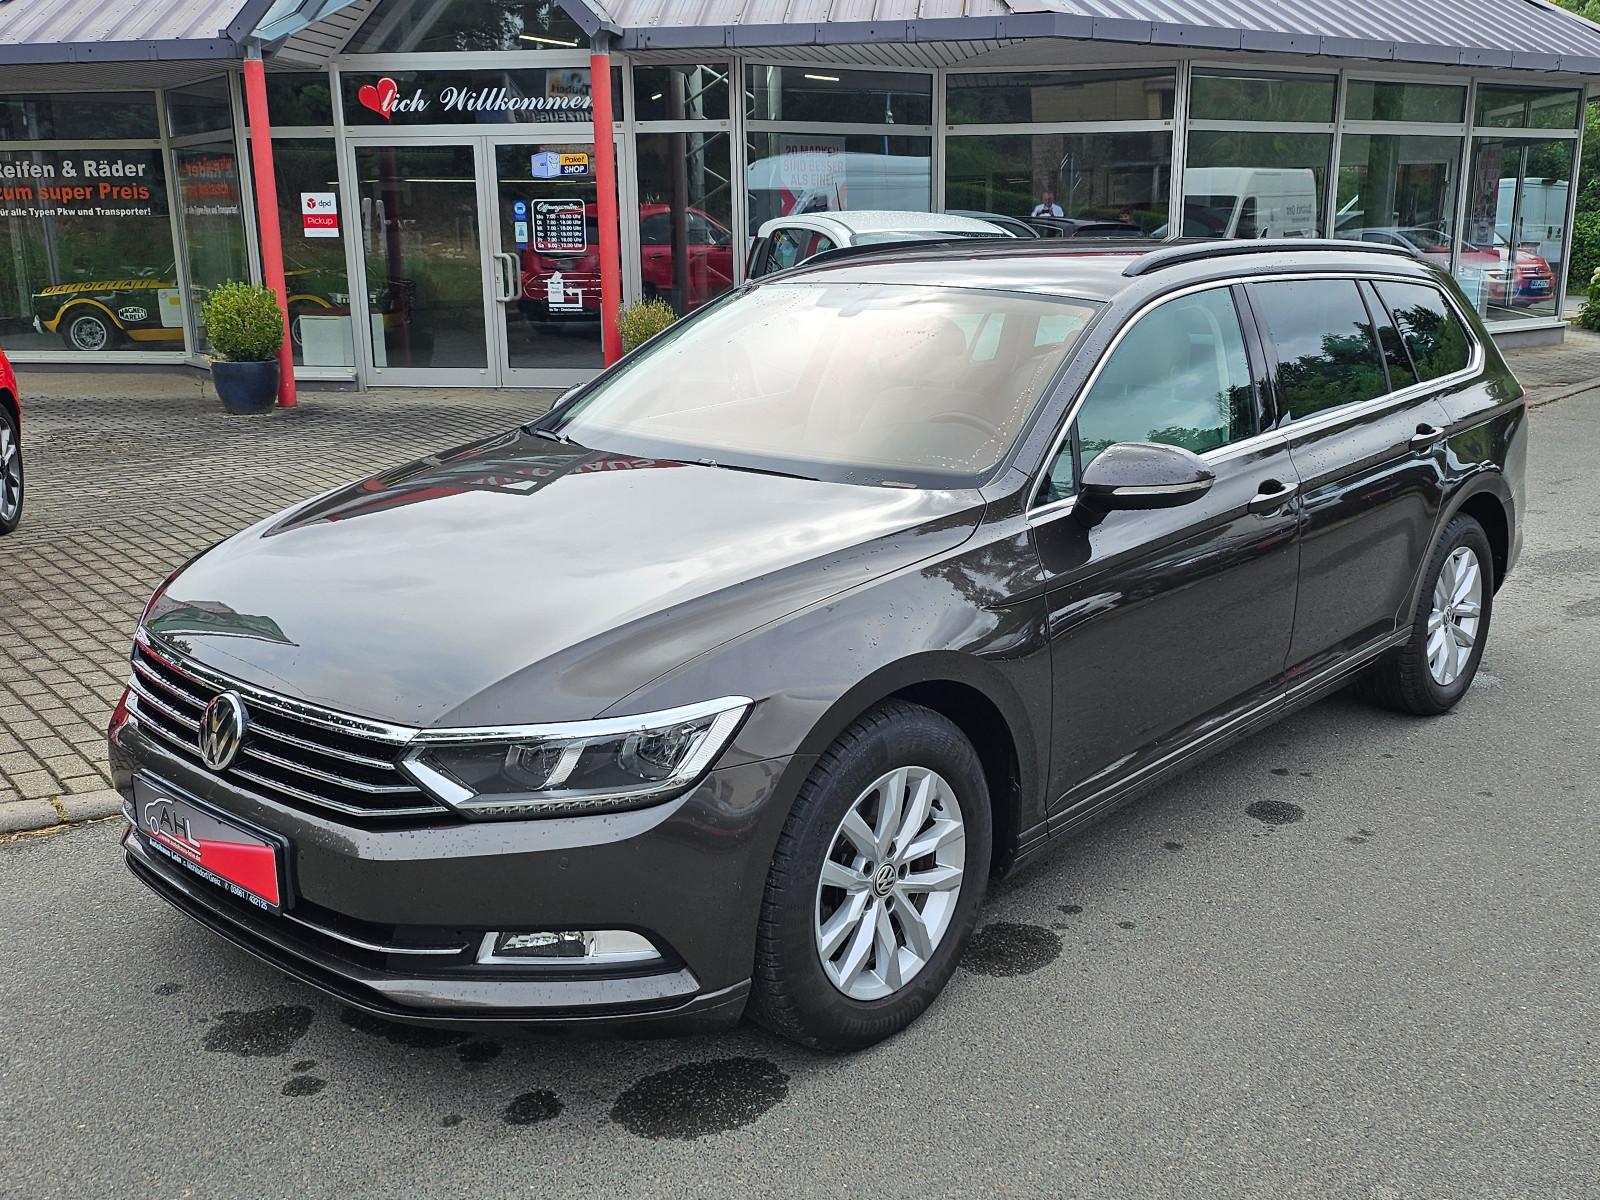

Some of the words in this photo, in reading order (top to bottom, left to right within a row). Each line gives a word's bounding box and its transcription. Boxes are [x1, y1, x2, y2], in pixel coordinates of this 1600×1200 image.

[381, 88, 431, 112] lich
[564, 156, 585, 164] Paket
[0, 161, 55, 178] eifen
[61, 160, 77, 178] &
[83, 160, 146, 177] Räder
[564, 165, 585, 174] SHOP
[38, 186, 93, 203] super
[98, 182, 150, 199] Preis
[318, 200, 331, 208] dpd
[0, 208, 8, 217] ür
[11, 208, 27, 217] alle
[29, 208, 55, 218] Typen
[57, 207, 76, 216] Pkw
[77, 207, 94, 216] und
[95, 207, 151, 217] Transporter!
[307, 216, 334, 226] Pickup
[160, 806, 200, 848] AHL
